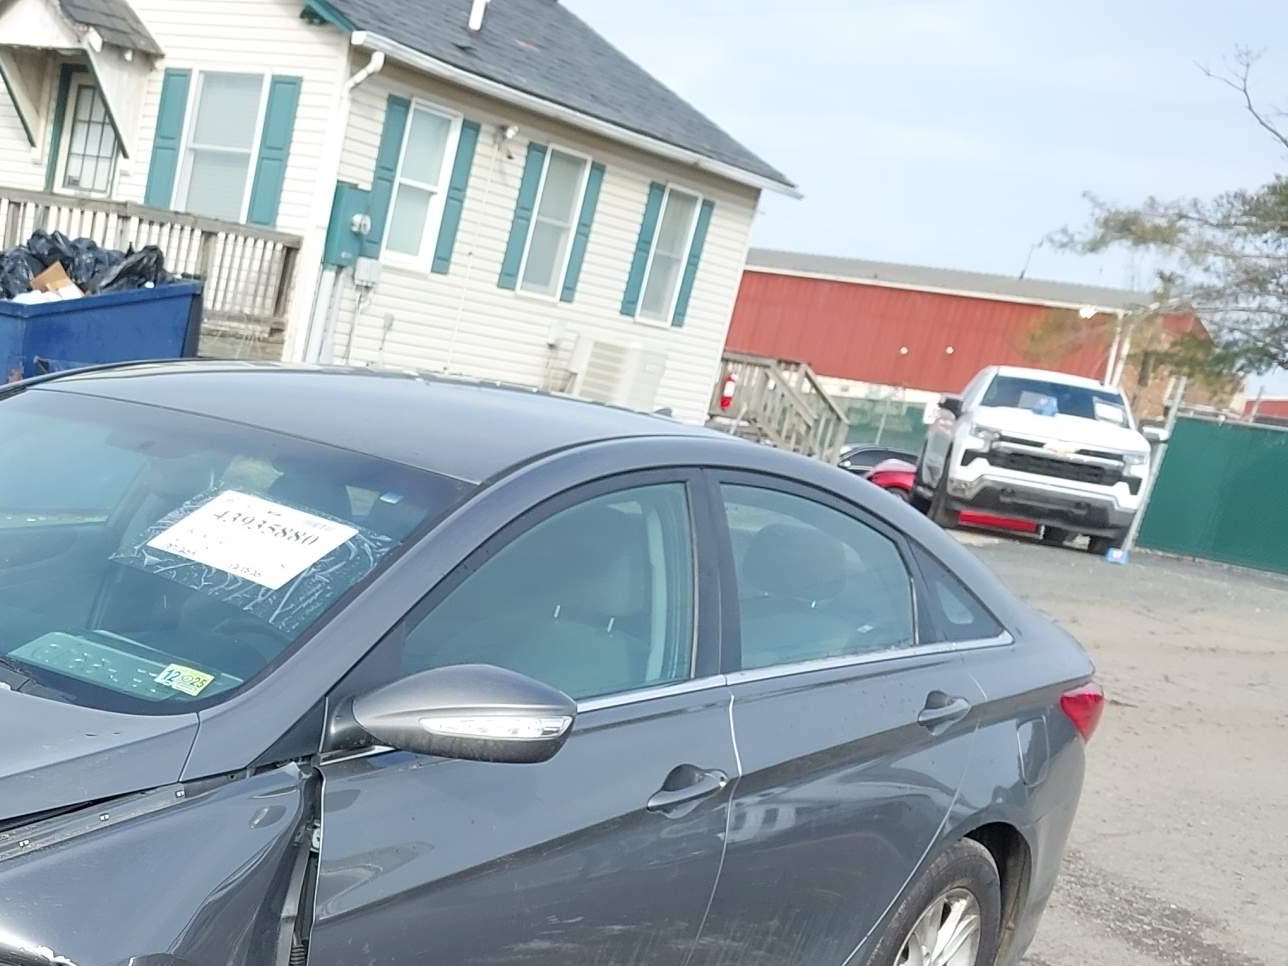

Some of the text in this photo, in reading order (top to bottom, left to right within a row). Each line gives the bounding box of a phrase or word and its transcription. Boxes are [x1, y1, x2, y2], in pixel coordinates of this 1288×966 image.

[213, 509, 320, 545] 43935880
[163, 669, 207, 688] 12 25
